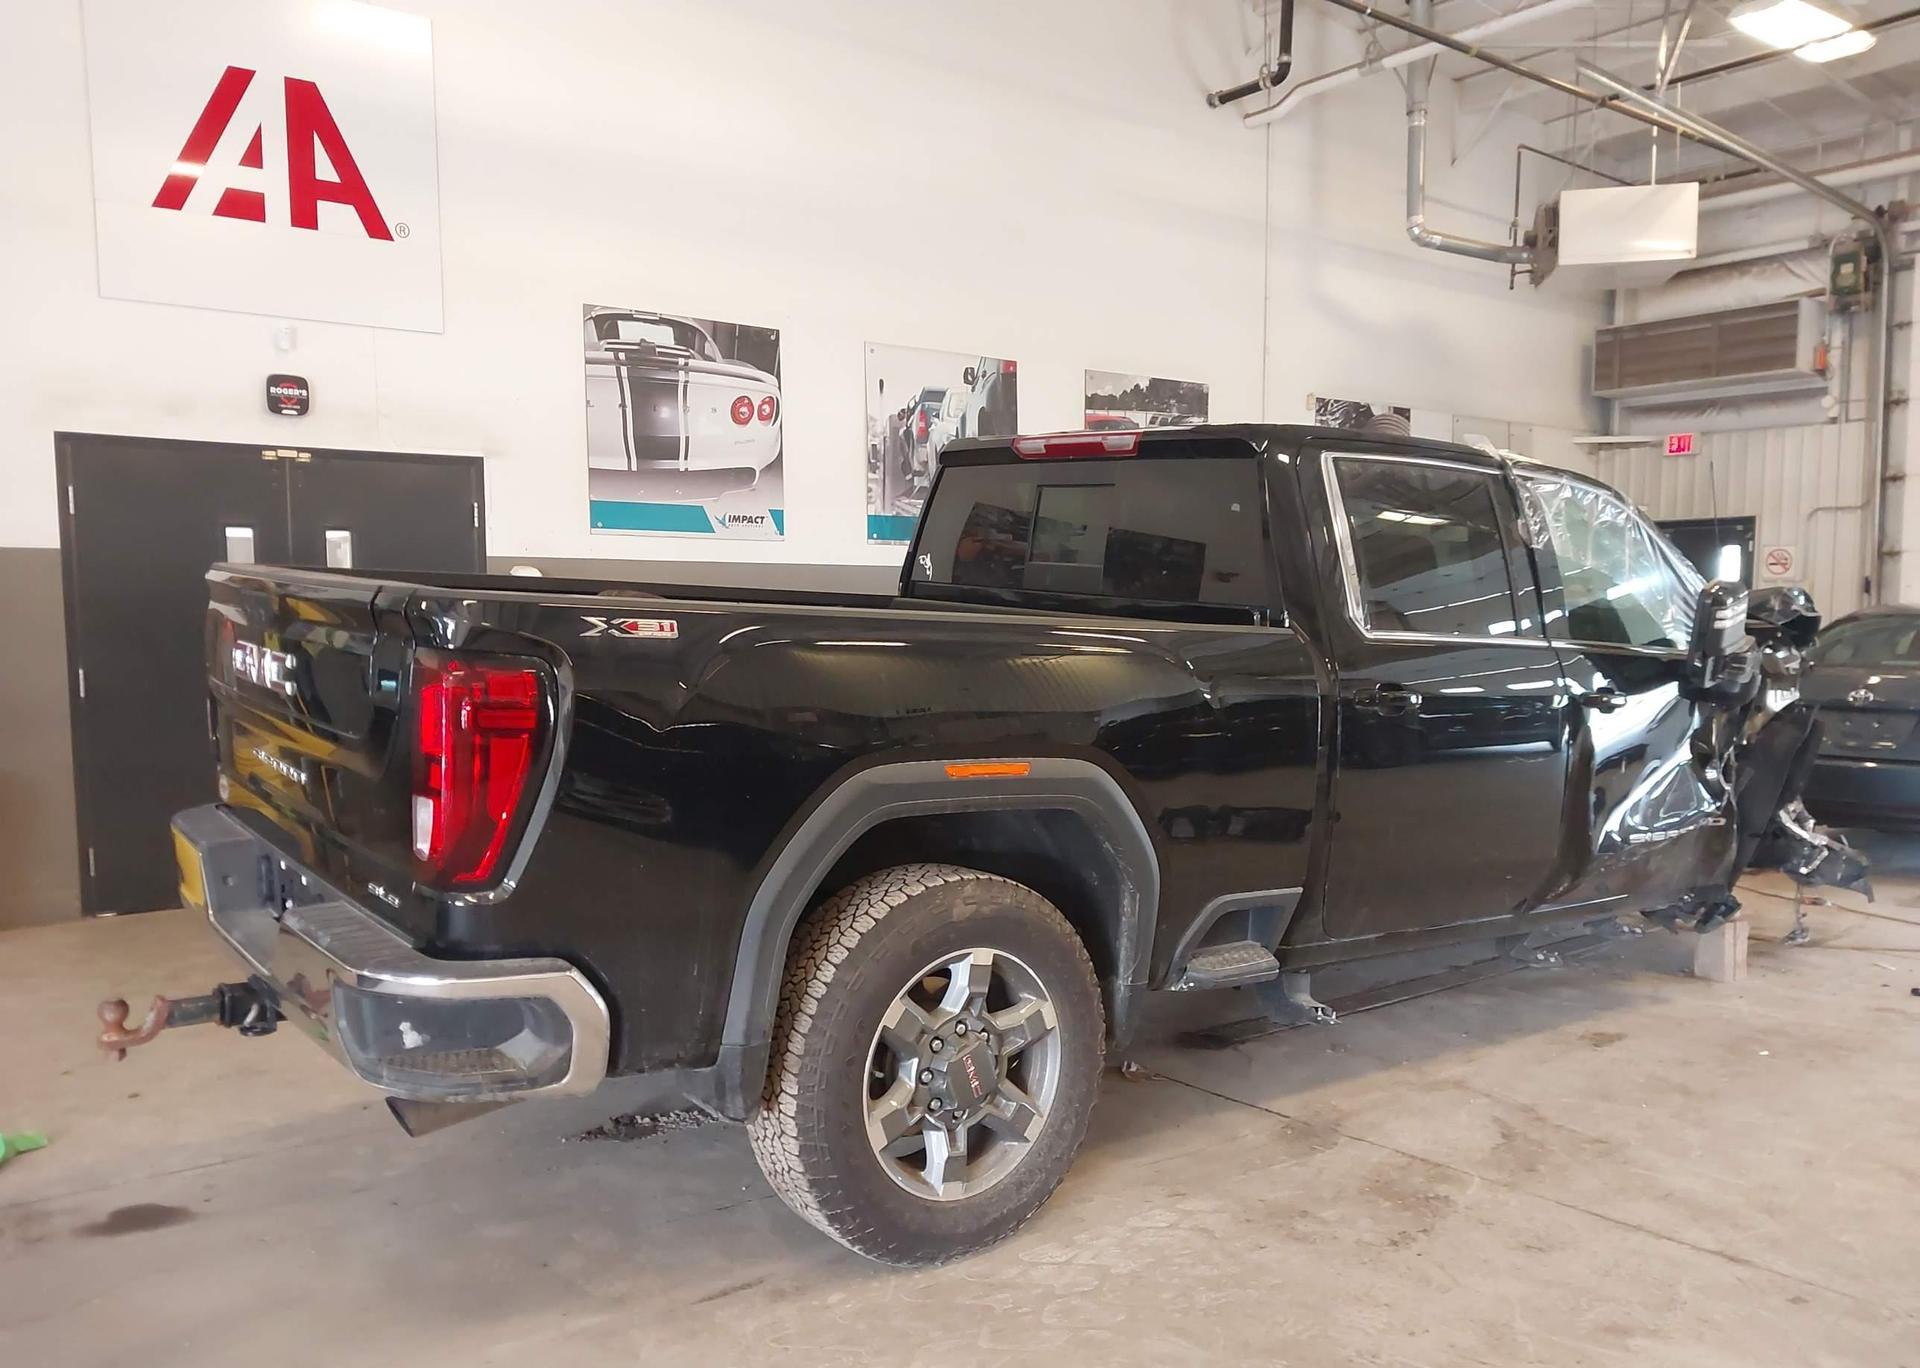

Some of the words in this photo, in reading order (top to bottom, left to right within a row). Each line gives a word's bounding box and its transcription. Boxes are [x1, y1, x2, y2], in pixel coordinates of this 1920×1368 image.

[270, 386, 308, 396] ROGER'S
[1668, 434, 1692, 453] EXIT
[728, 514, 765, 524] IMPACT
